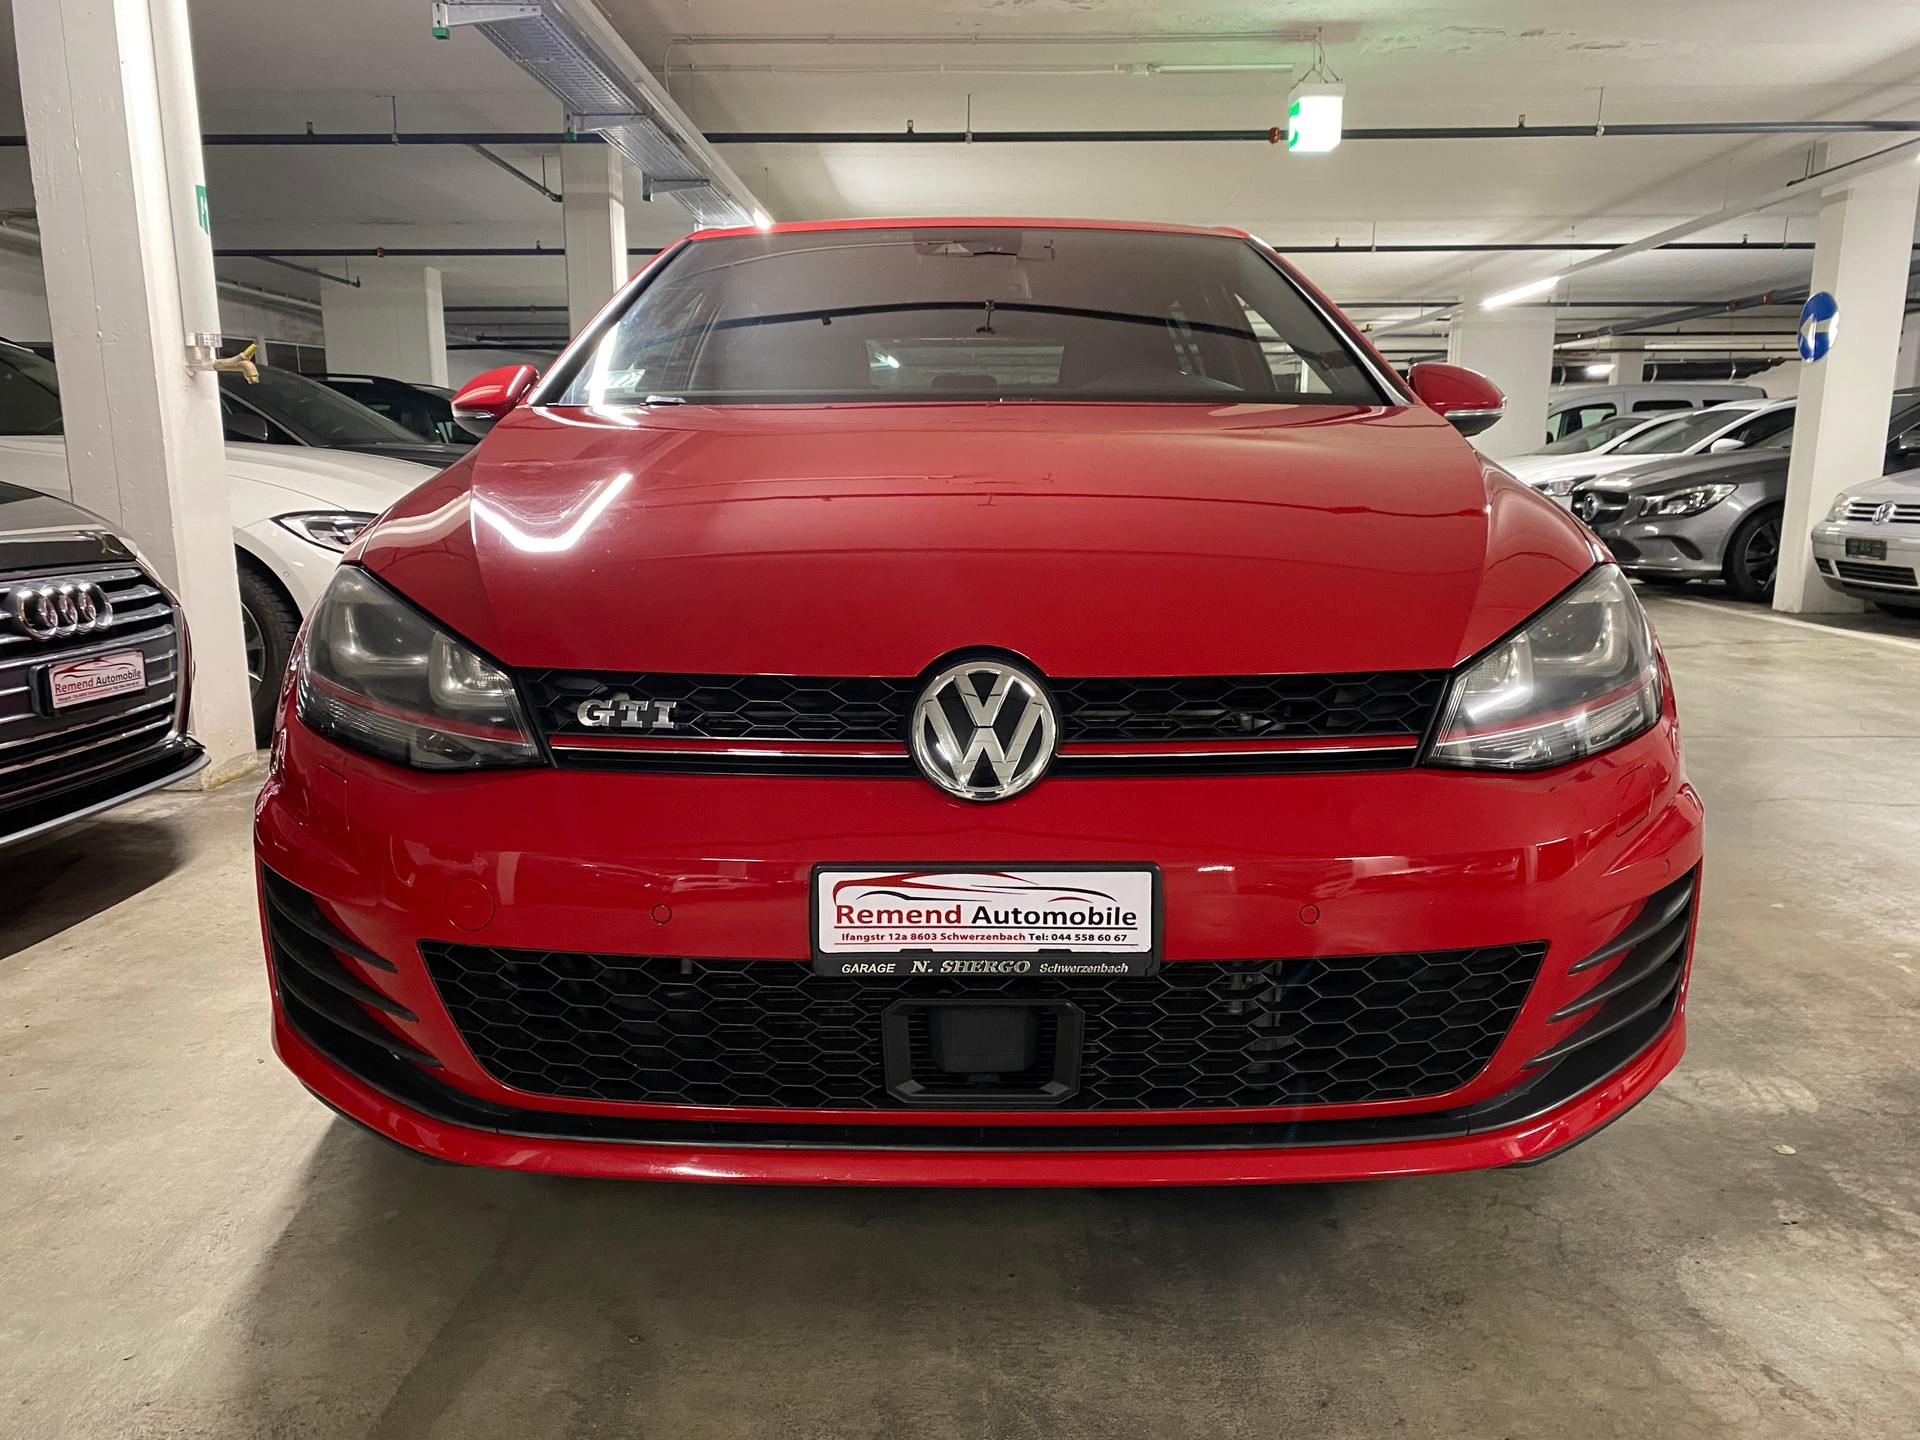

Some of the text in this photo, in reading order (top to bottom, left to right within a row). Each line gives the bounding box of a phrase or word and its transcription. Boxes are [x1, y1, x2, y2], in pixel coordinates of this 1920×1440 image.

[55, 677, 94, 694] Remend
[95, 669, 142, 686] Automobile
[577, 699, 677, 729] GTI
[916, 664, 1052, 798] VW
[835, 904, 1137, 926] Remend Automobile
[841, 932, 1128, 943] Ifangstr 12a 8603 Schwerzenbach Tel: 044 558 60 67
[841, 960, 1129, 974] GARAGE N. SHERGO Schwerzenbach
